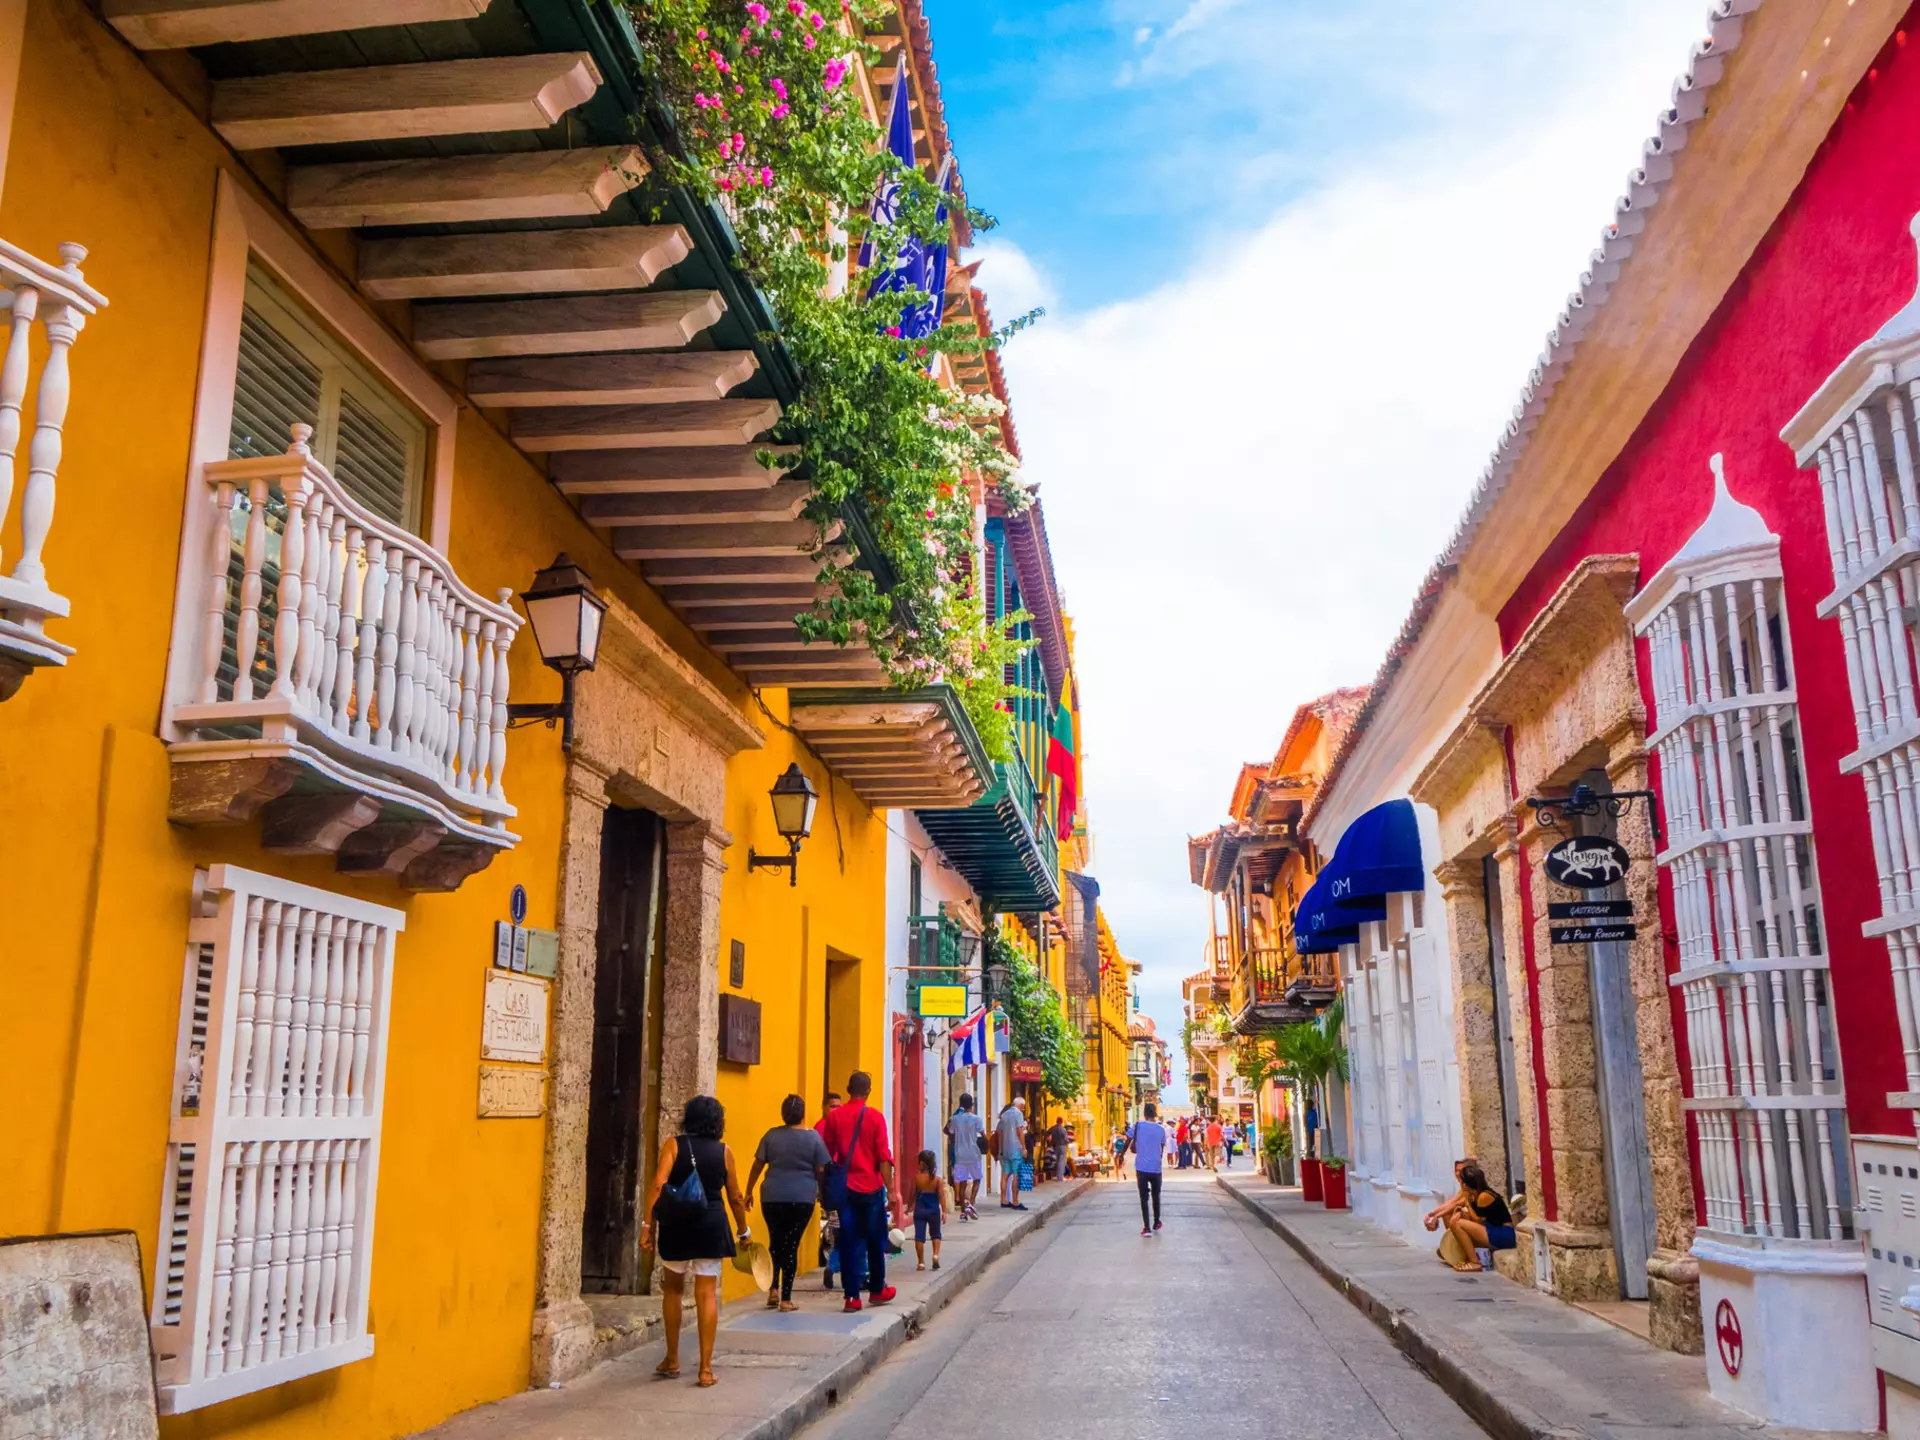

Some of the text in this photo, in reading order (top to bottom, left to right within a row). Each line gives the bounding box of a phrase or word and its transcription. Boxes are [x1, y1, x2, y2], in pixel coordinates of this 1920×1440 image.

[1332, 877, 1351, 898] OM
[1569, 905, 1611, 917] GASTROBAR
[1311, 912, 1326, 930] OM
[1296, 934, 1309, 950] OM
